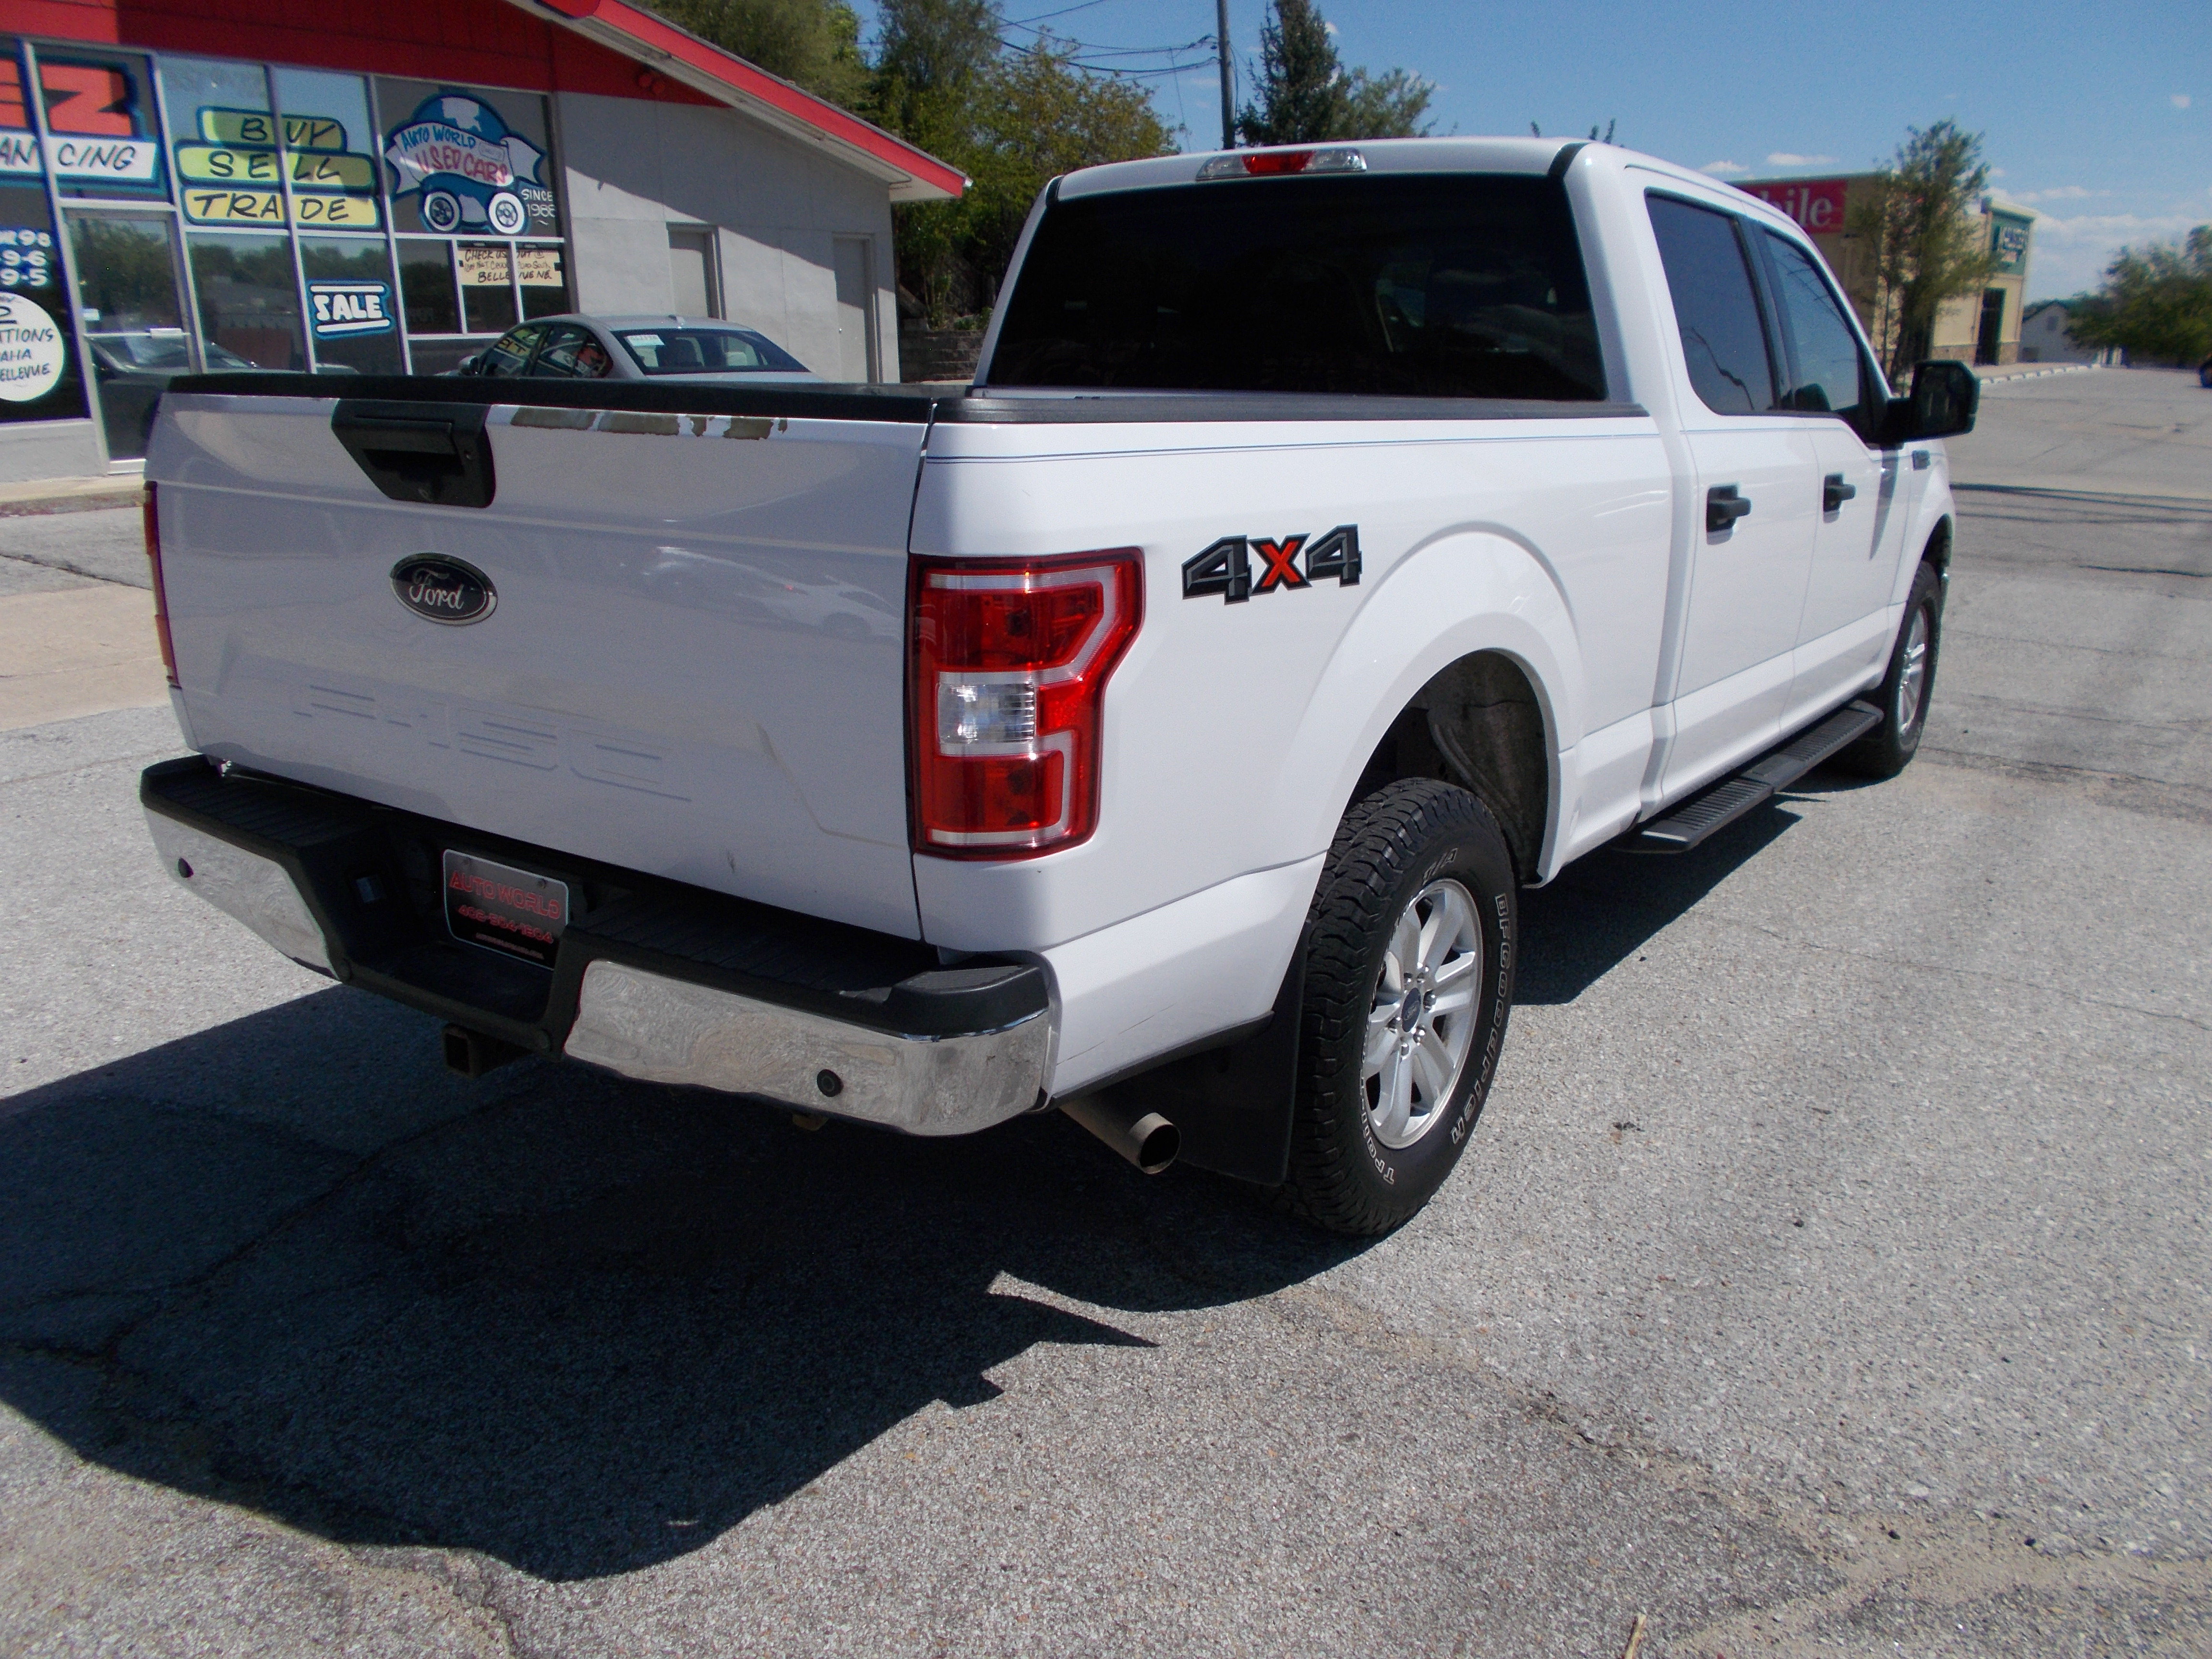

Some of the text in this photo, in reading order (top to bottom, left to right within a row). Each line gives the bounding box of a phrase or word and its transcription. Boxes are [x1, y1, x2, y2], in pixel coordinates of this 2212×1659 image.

[240, 117, 336, 146] BUY
[401, 125, 476, 151] AUTO WORLD
[208, 150, 340, 181] SELL
[415, 145, 461, 174] USED
[463, 153, 508, 184] CARS
[194, 192, 349, 221] TRADE
[521, 189, 553, 202] SINCE
[465, 249, 493, 262] CHECK
[313, 294, 383, 321] SALE
[0, 328, 54, 343] TIONS
[0, 348, 31, 361] AHA
[0, 362, 50, 382] ELLEVUE
[409, 567, 465, 610] Ford
[448, 870, 561, 920] AUTO WORLD
